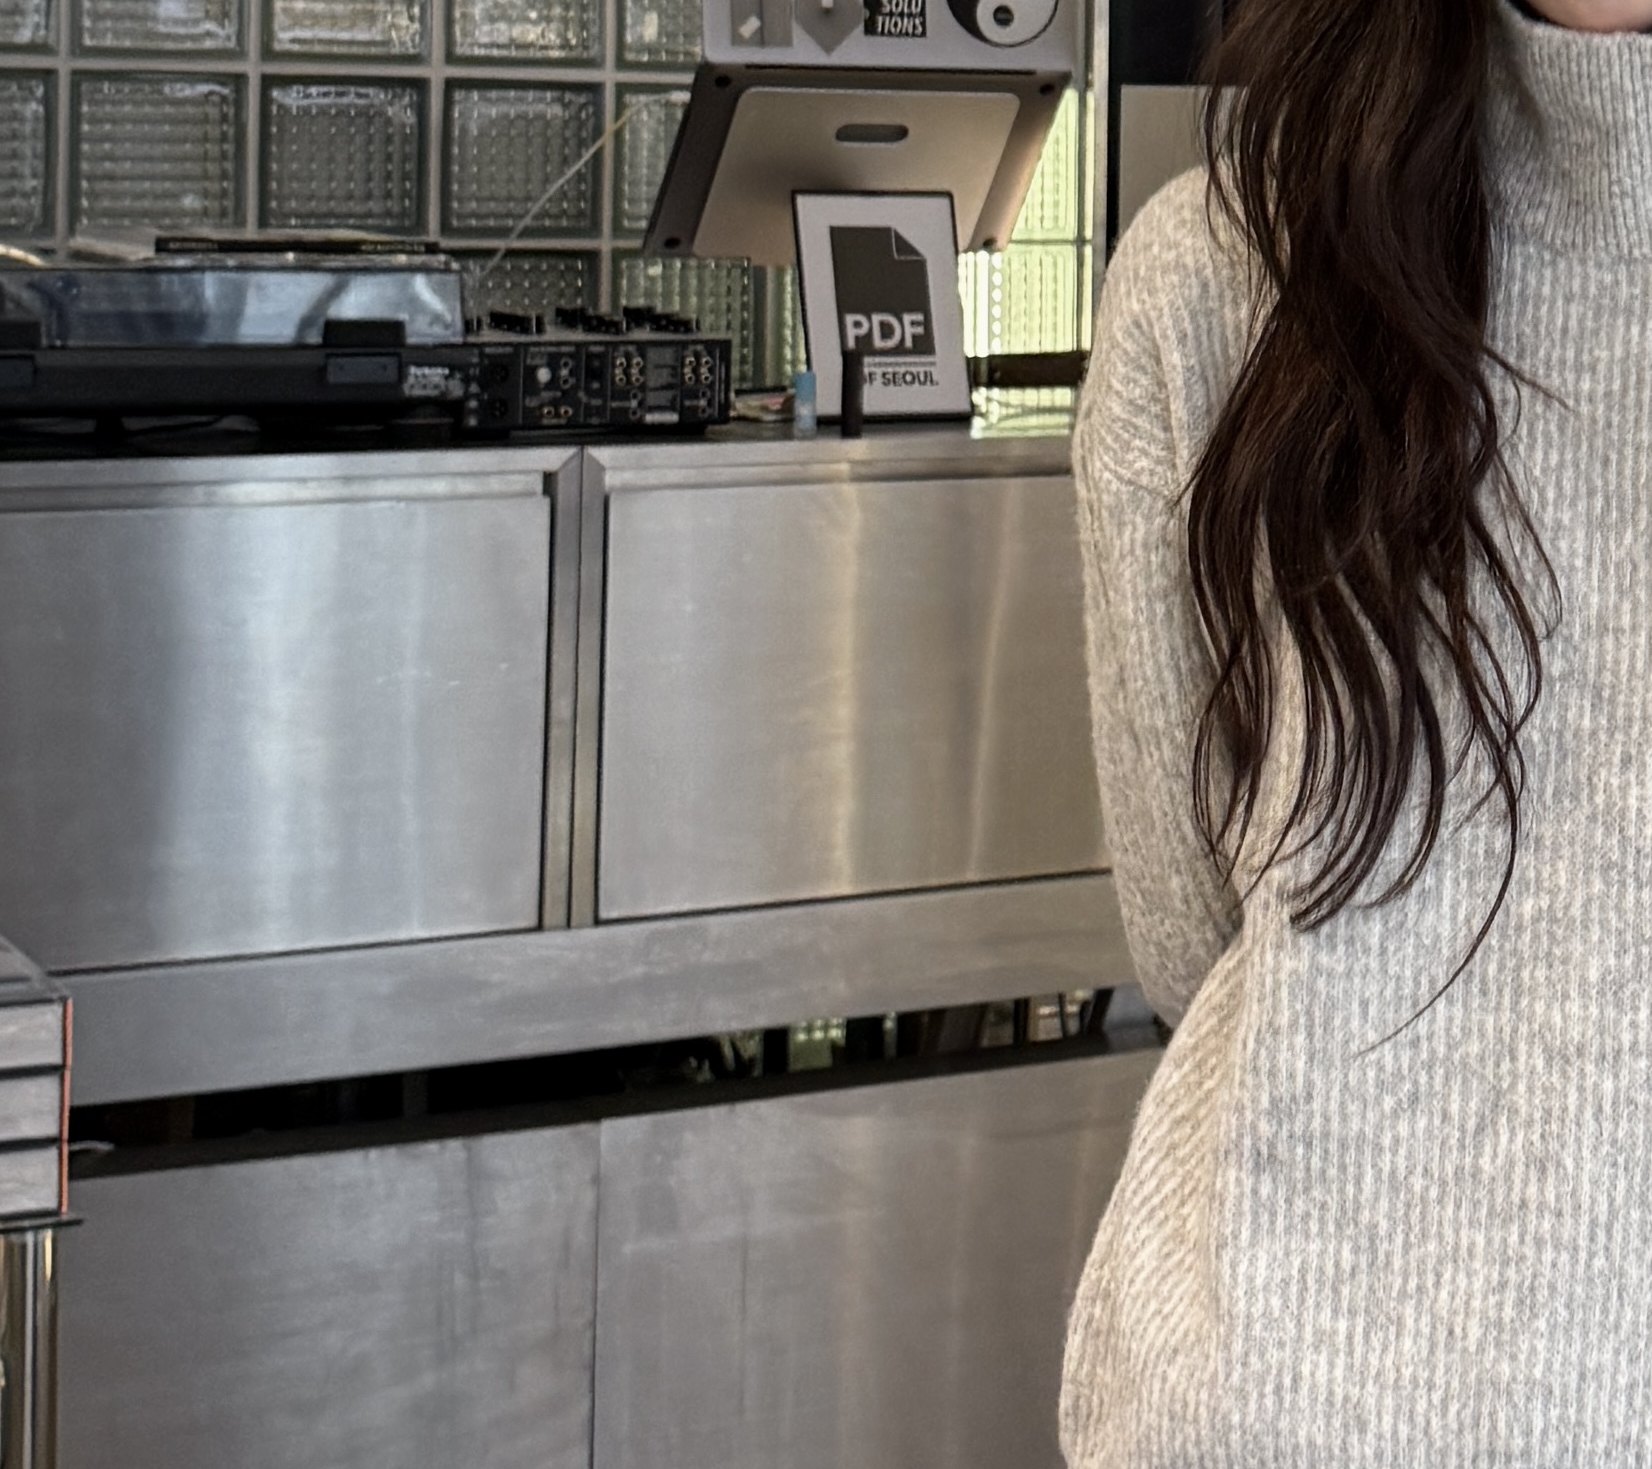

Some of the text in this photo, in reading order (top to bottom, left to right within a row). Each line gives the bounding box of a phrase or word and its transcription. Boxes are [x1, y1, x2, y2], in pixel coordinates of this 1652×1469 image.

[876, 15, 924, 36] TIONS
[844, 311, 926, 351] PDF
[881, 369, 936, 387] SEOUL
